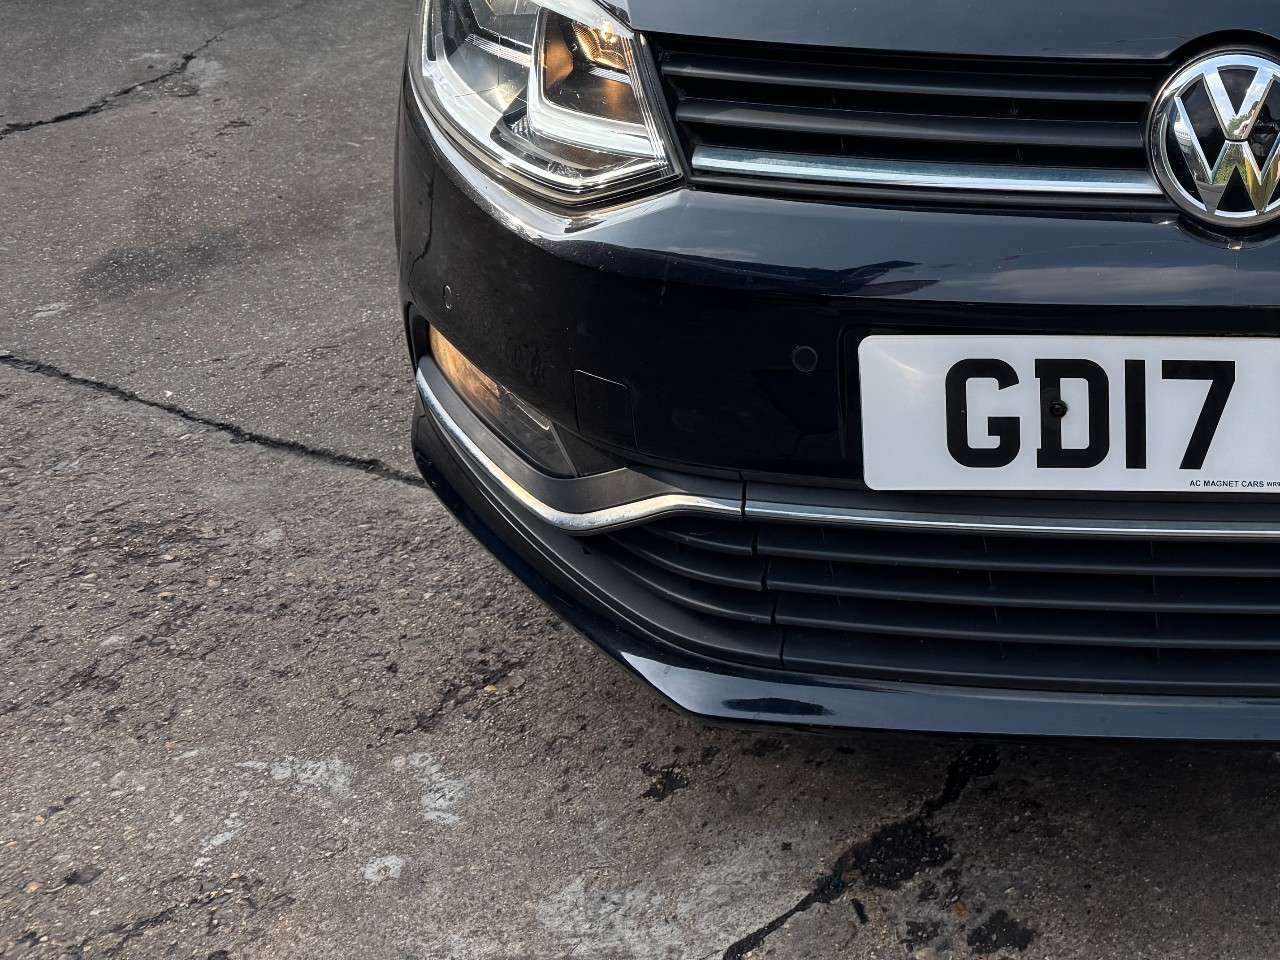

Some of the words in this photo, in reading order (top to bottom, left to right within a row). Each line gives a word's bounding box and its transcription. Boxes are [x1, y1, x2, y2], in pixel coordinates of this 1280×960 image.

[944, 358, 1237, 470] GD17
[1189, 479, 1201, 487] AC
[1203, 479, 1240, 488] MAGNET
[1241, 480, 1265, 488] CARS
